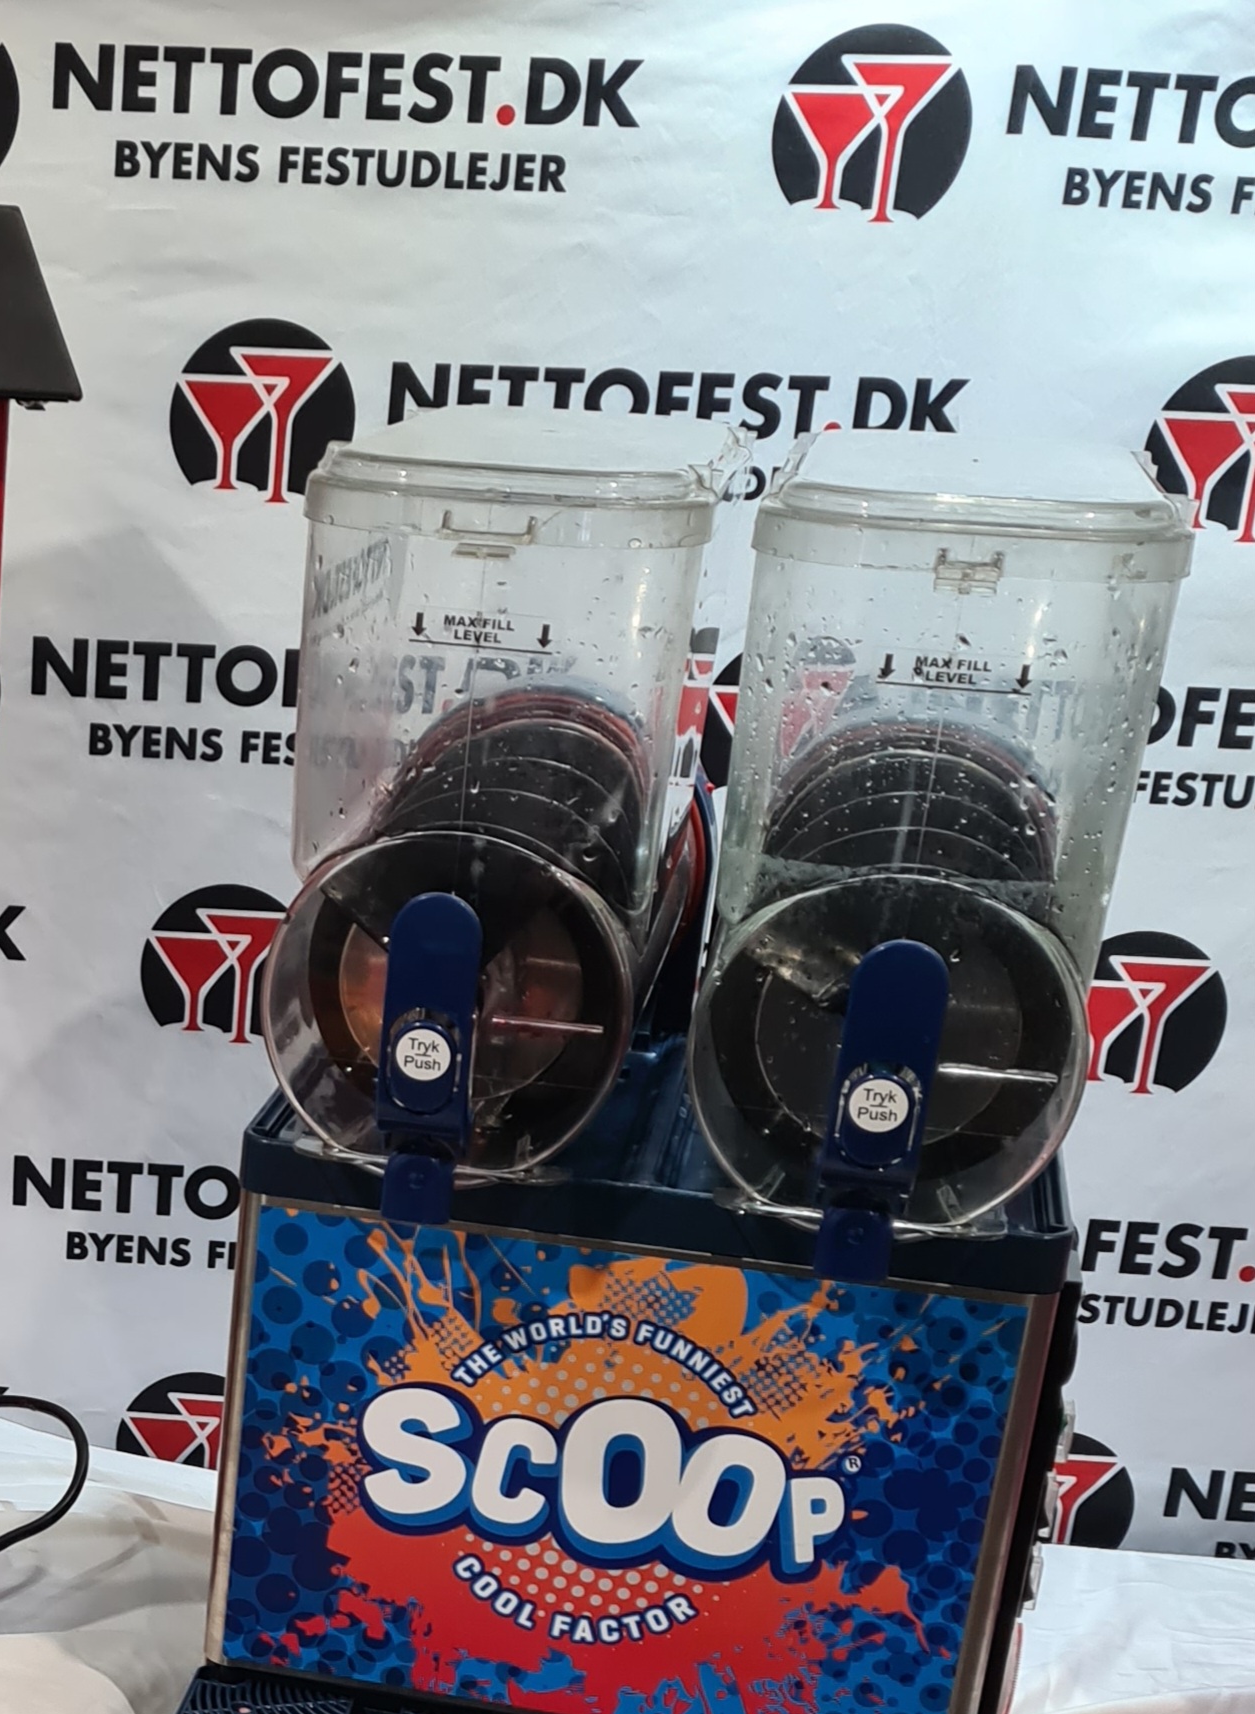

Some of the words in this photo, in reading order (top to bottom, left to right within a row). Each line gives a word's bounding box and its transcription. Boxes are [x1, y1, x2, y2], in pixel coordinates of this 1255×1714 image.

[53, 42, 645, 129] NETTOFEST.DK
[114, 140, 261, 184] BYENS
[278, 145, 568, 193] FESTUDLEJER
[1063, 167, 1215, 214] BYENS
[443, 615, 477, 629] MAX
[482, 618, 515, 632] FILL
[453, 629, 502, 644] LEVEL
[914, 654, 952, 669] MAX
[957, 660, 992, 673] FILL
[924, 671, 977, 685] LEVEL
[88, 722, 223, 762] BYENS
[408, 1038, 440, 1055] Tryk
[403, 1055, 441, 1071] Push
[863, 1088, 897, 1105] Tryk
[857, 1106, 898, 1122] Push
[65, 1231, 191, 1267] BYENS
[451, 1344, 502, 1385] THE
[507, 1312, 630, 1352] WORLD'S
[636, 1322, 758, 1418] FUNNIEST
[455, 1555, 536, 1629] COOL
[550, 1597, 697, 1643] FACTOR
